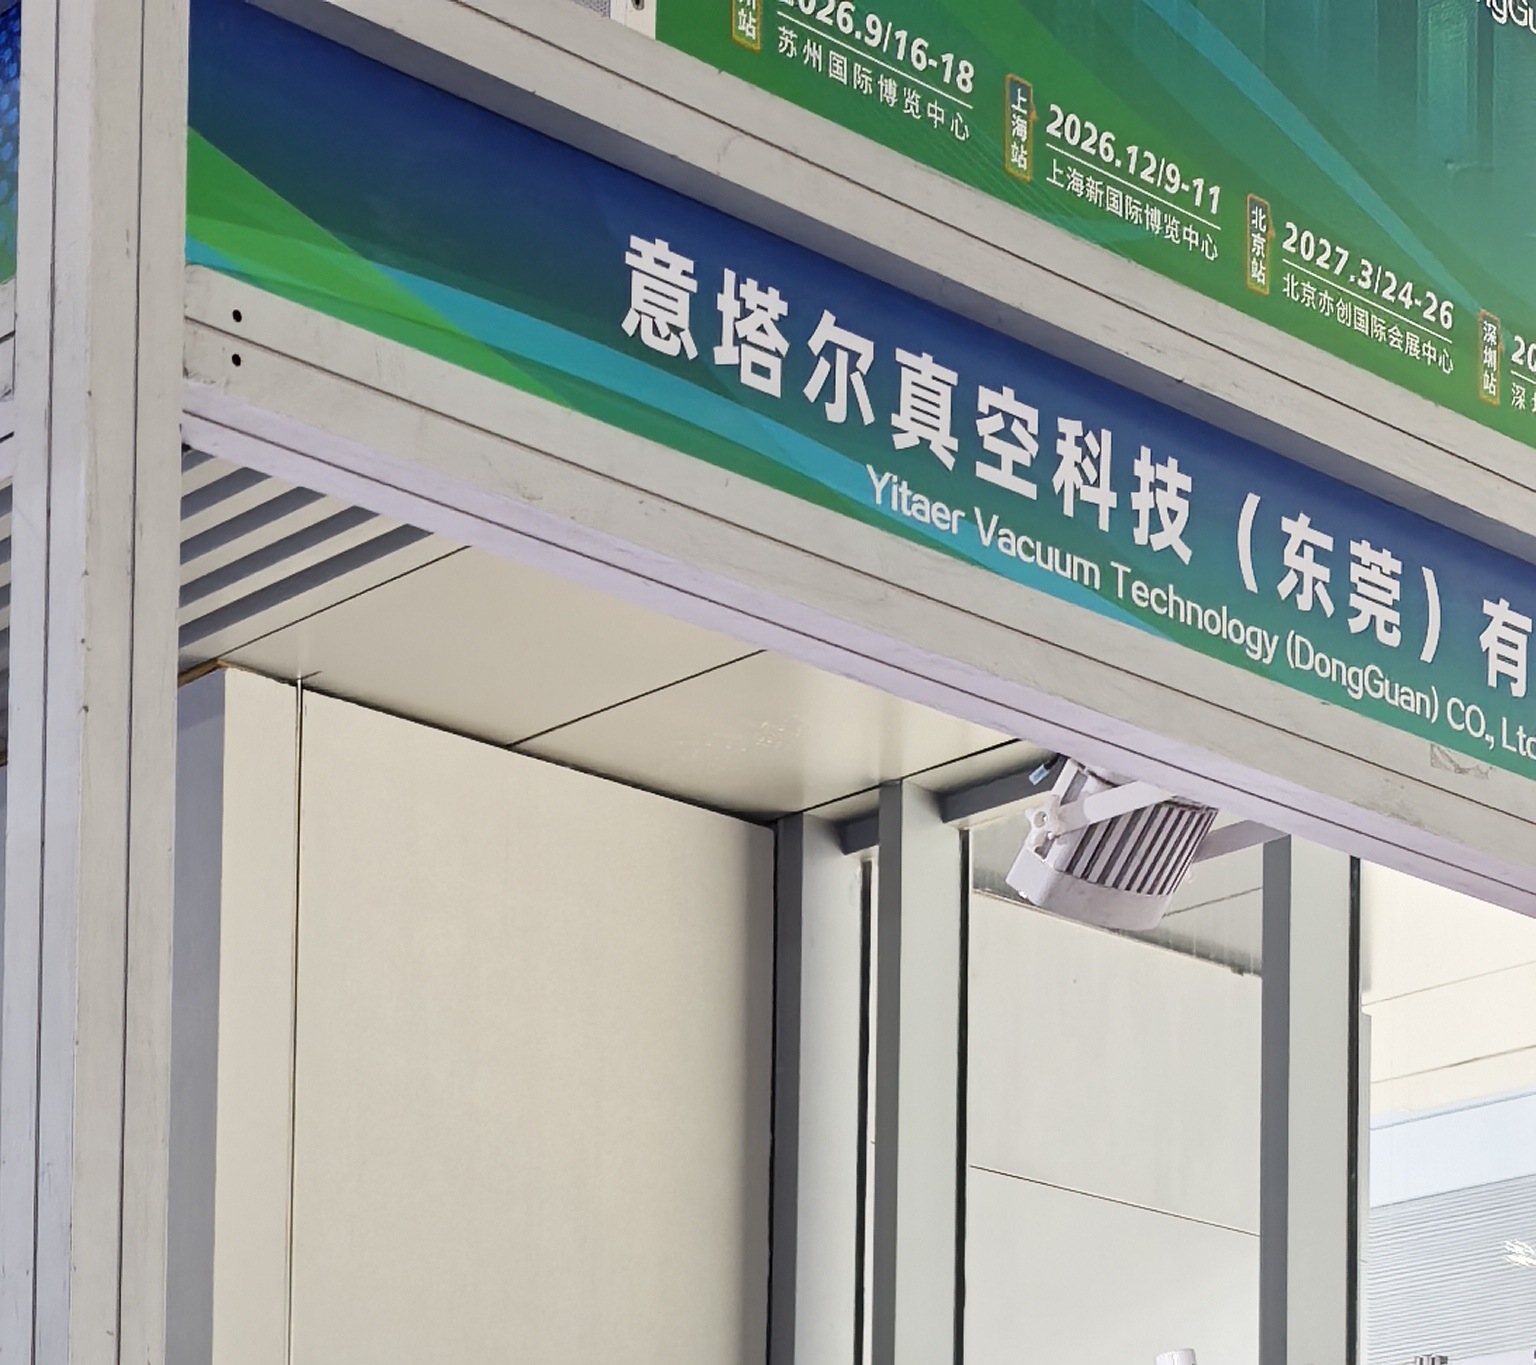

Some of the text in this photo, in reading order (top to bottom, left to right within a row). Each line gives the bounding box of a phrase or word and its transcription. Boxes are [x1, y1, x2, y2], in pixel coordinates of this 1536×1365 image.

[777, 25, 970, 141] 苏州国际博览中心
[780, 0, 975, 93] 26.9/16-18
[1010, 88, 1028, 171] 上海站
[1046, 104, 1221, 215] 2026.12/9-11
[1046, 159, 1219, 262] 上海新国际博览中心
[1251, 206, 1267, 285] 北京站
[1282, 221, 1454, 330] 2027.3/24-26
[1282, 272, 1454, 375] 北京亦创国际会展中心
[621, 234, 1533, 698] 意塔尔真空科技（东莞）有
[867, 463, 965, 535] Yitaer
[974, 505, 1102, 591] Vacuum
[1112, 562, 1279, 665] Technology
[1286, 630, 1439, 724] (DongGuan)
